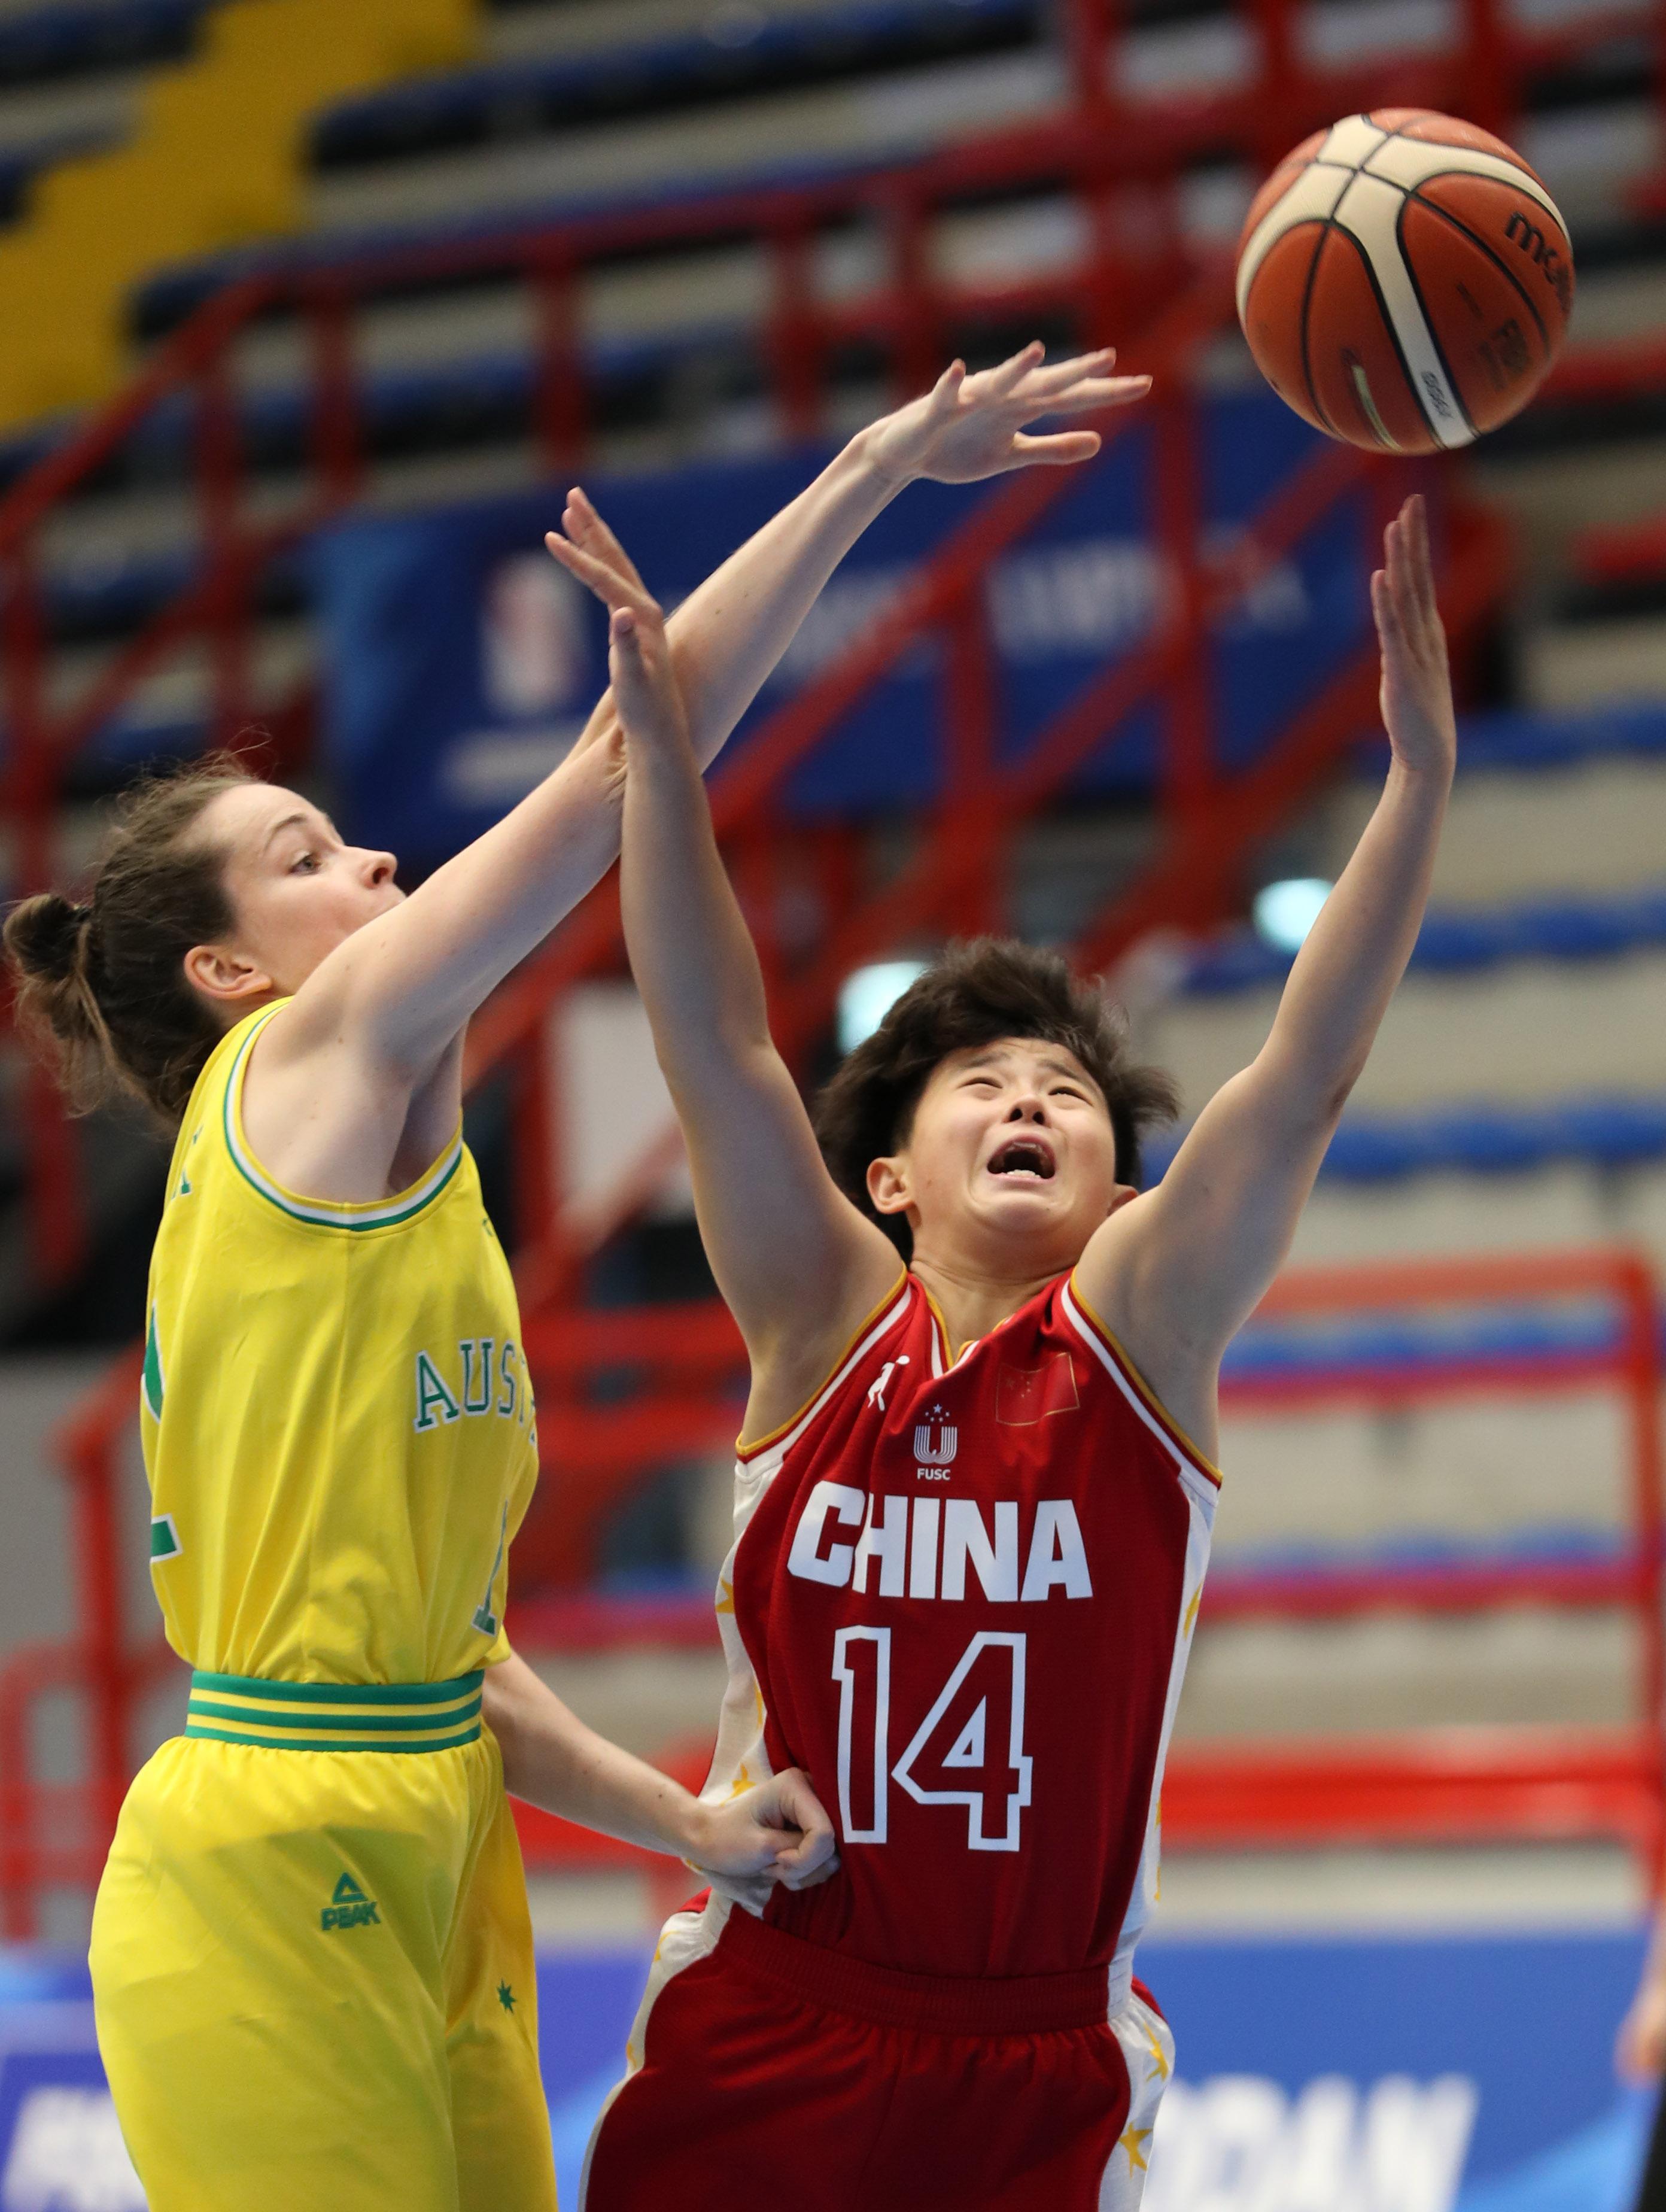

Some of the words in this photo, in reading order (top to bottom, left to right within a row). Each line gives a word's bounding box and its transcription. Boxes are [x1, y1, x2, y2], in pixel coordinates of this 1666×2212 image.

[917, 1467, 951, 1481] FUSC
[787, 1480, 1093, 1602] CHINA
[831, 1625, 1033, 1852] 14
[321, 1900, 381, 1931] PEAK
